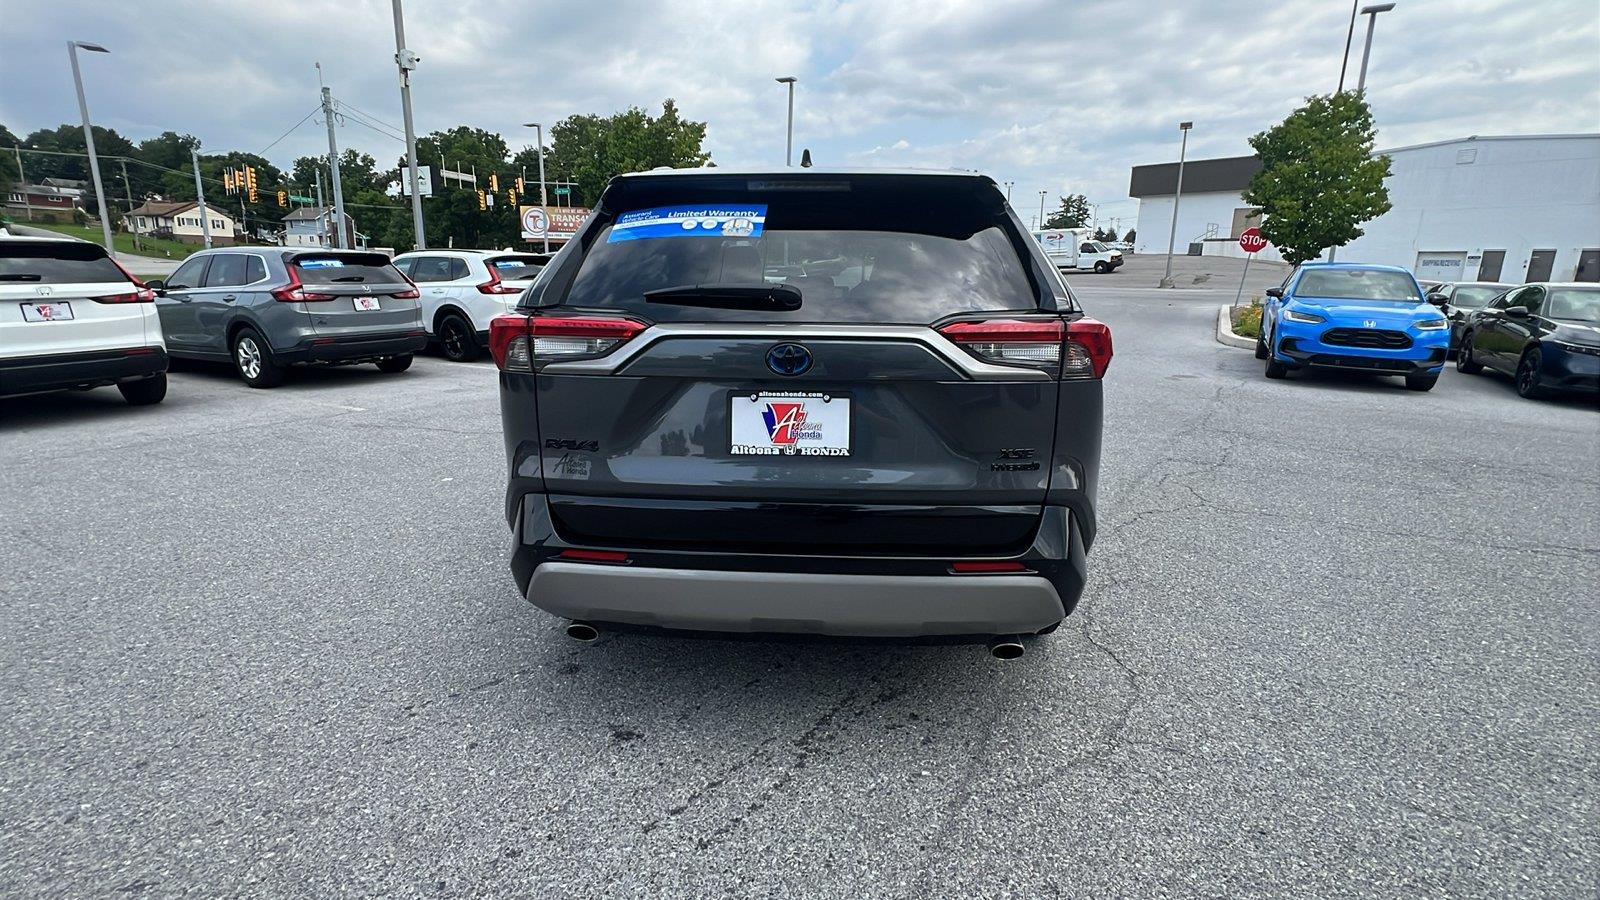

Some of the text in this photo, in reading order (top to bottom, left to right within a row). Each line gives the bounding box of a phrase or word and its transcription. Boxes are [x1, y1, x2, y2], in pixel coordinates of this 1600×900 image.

[667, 209, 759, 218] Limited Warranty
[759, 390, 824, 398] altoonahonda.com
[791, 430, 822, 440] Honda
[545, 439, 600, 452] RAV4
[730, 444, 850, 456] Altoona HONDA
[999, 447, 1036, 459] XSE
